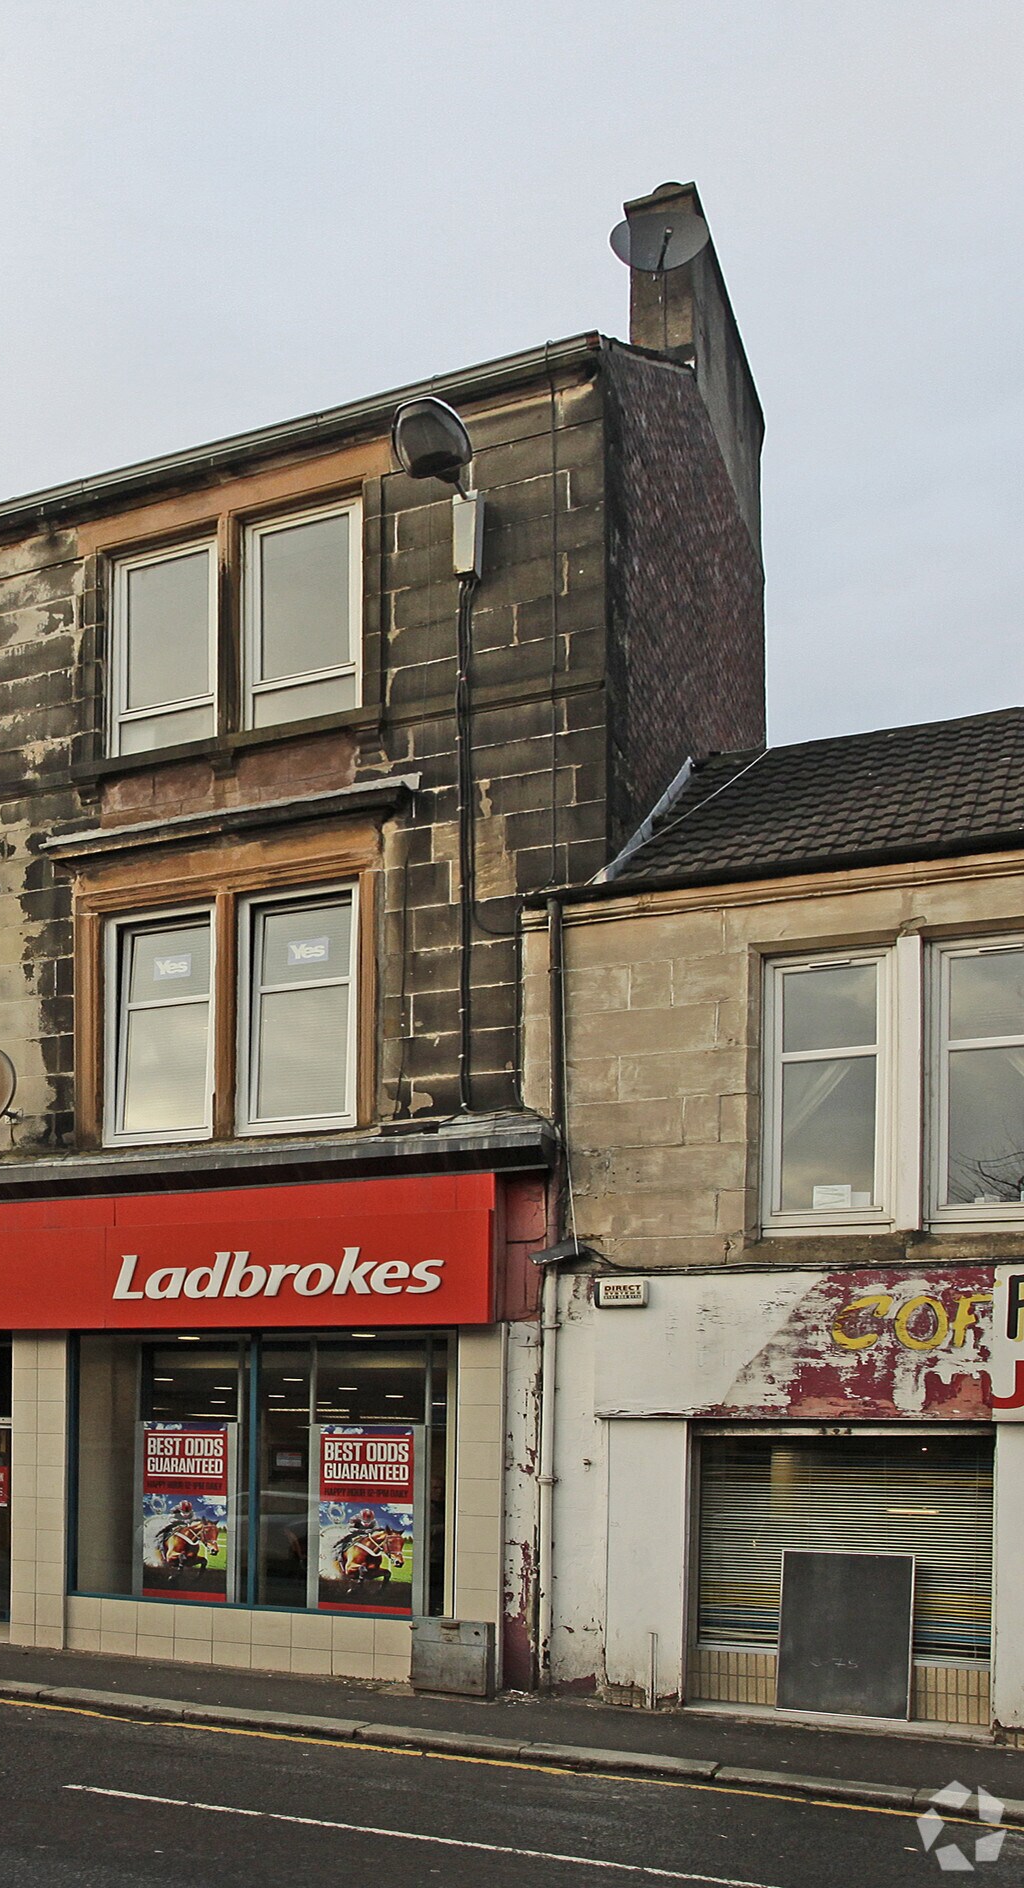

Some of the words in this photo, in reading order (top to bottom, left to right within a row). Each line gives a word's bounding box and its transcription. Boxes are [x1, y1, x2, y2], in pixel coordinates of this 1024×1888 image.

[290, 944, 326, 960] Yes
[156, 960, 188, 975] Yes
[112, 1247, 445, 1299] Ladbrokes
[147, 1437, 182, 1455] BEST
[184, 1438, 224, 1457] ODDS
[324, 1442, 363, 1461] BEST
[366, 1443, 409, 1462] ODDS
[147, 1457, 223, 1474] GUARANTEED
[324, 1463, 409, 1481] GUARANTEED
